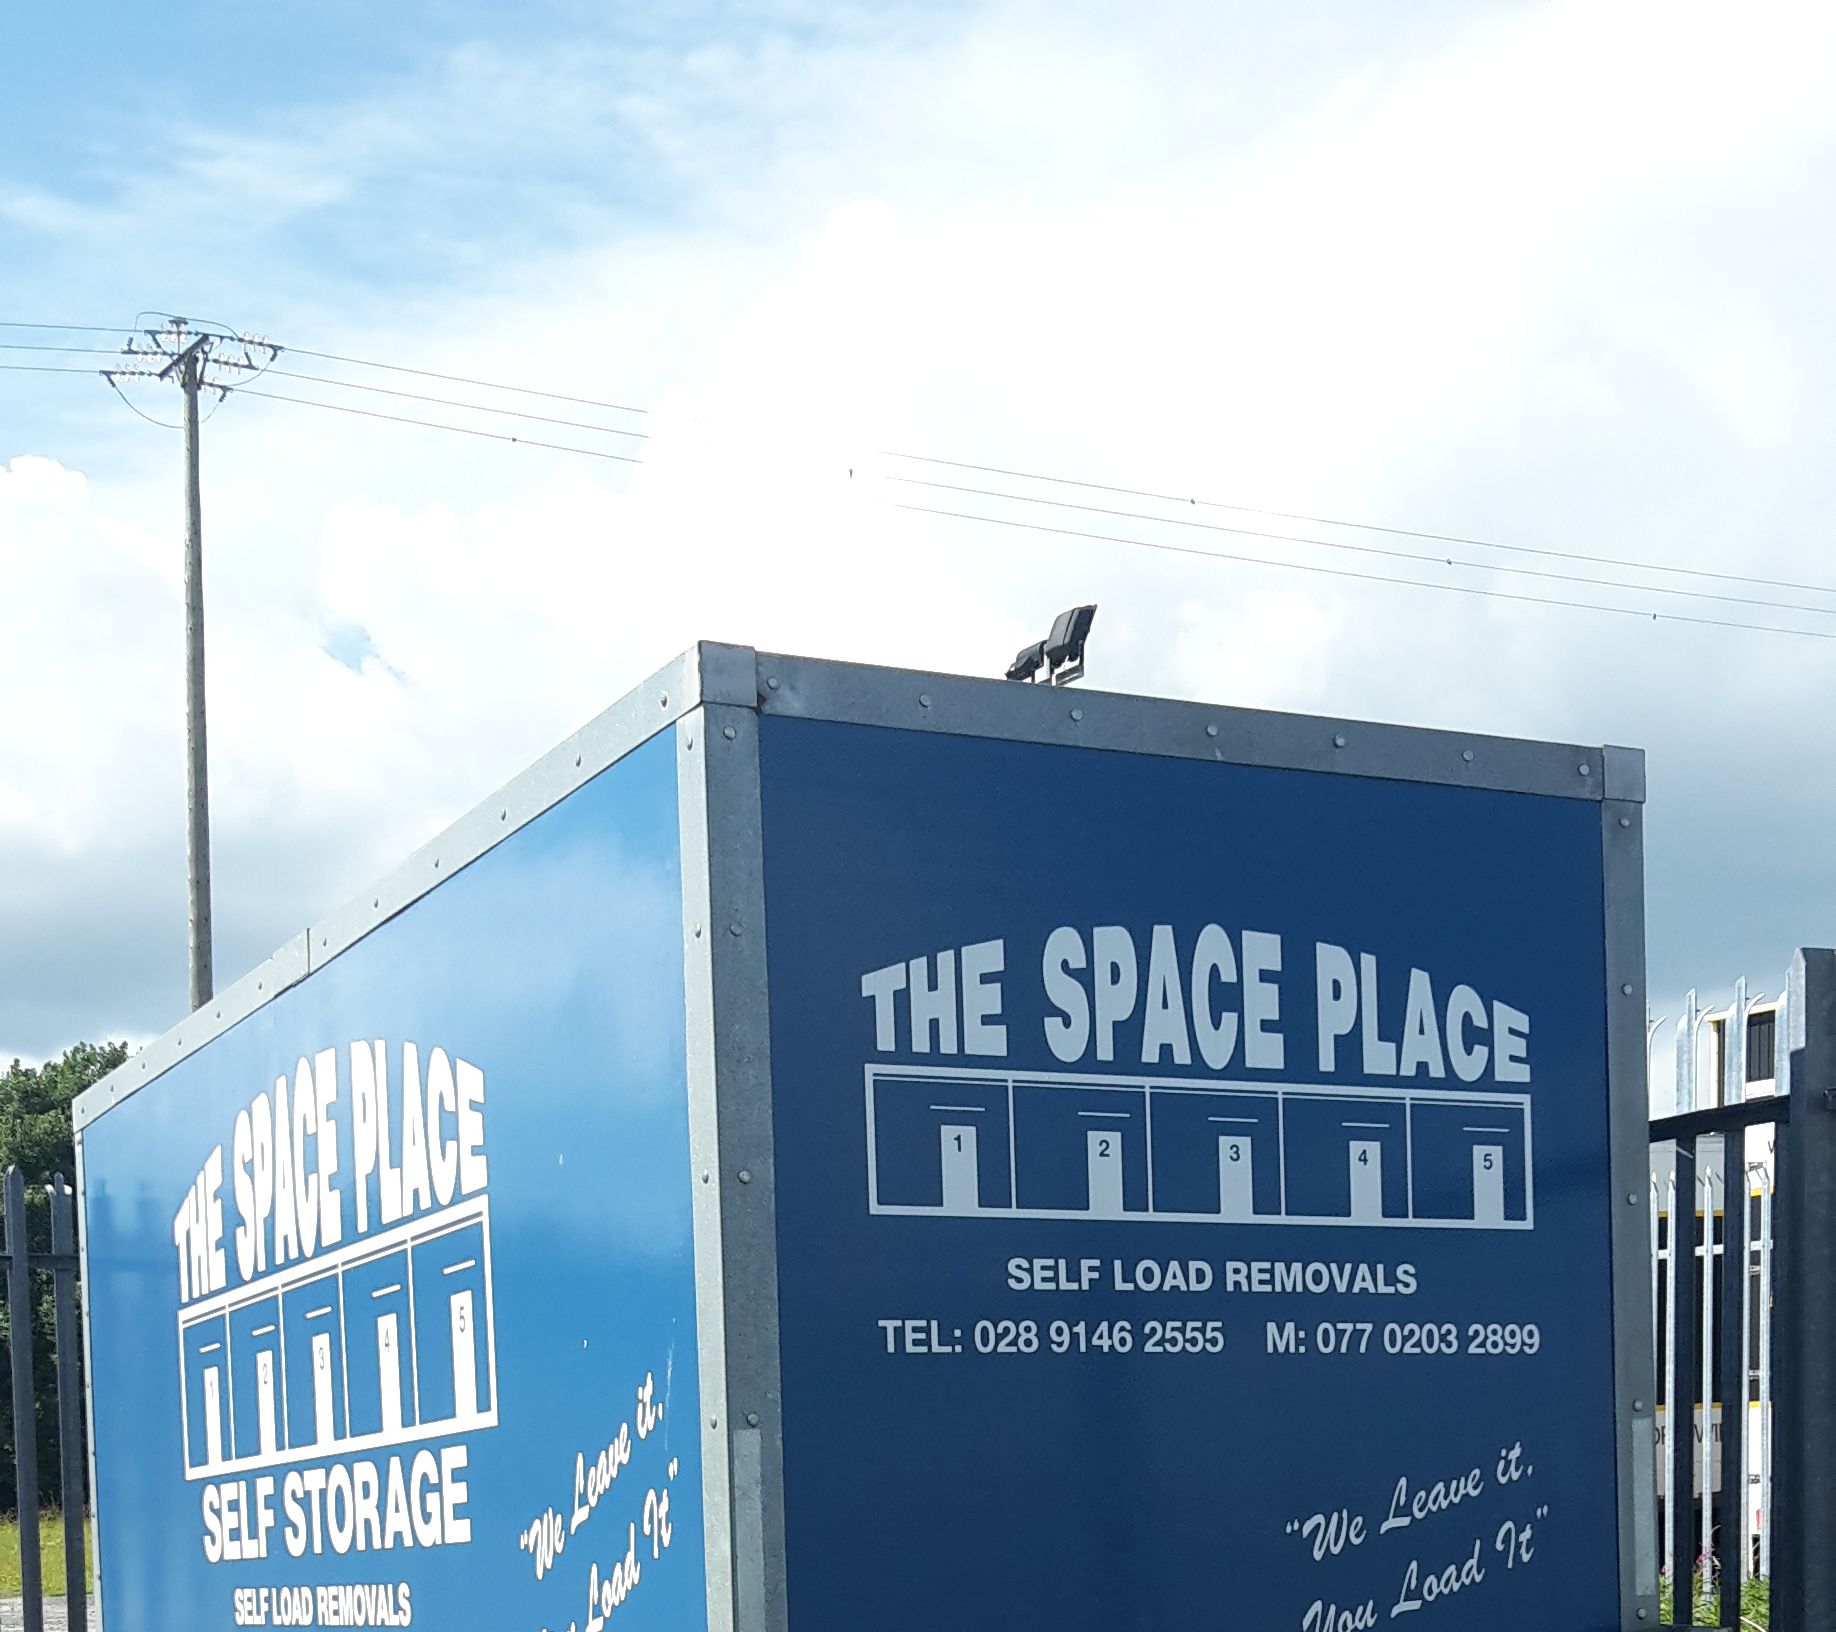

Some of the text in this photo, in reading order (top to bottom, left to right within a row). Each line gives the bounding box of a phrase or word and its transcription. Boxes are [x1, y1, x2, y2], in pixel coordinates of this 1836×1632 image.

[862, 924, 1531, 1083] THE SPACE PLACE
[174, 1039, 488, 1304] THE SPACE PLACE
[953, 1133, 1494, 1171] 1 2 3 4 5
[1007, 1257, 1418, 1295] SELF LOAD REMOVALS
[877, 1319, 1540, 1355] TEL: 028 9146 2555 M: 077 0203 2899
[203, 1445, 472, 1563] SELF STORAGE
[570, 1422, 631, 1536] Leave
[1379, 1468, 1484, 1535] Leave
[234, 1582, 412, 1628] SELF LOAD REMOVALS
[1390, 1539, 1485, 1619] Load
